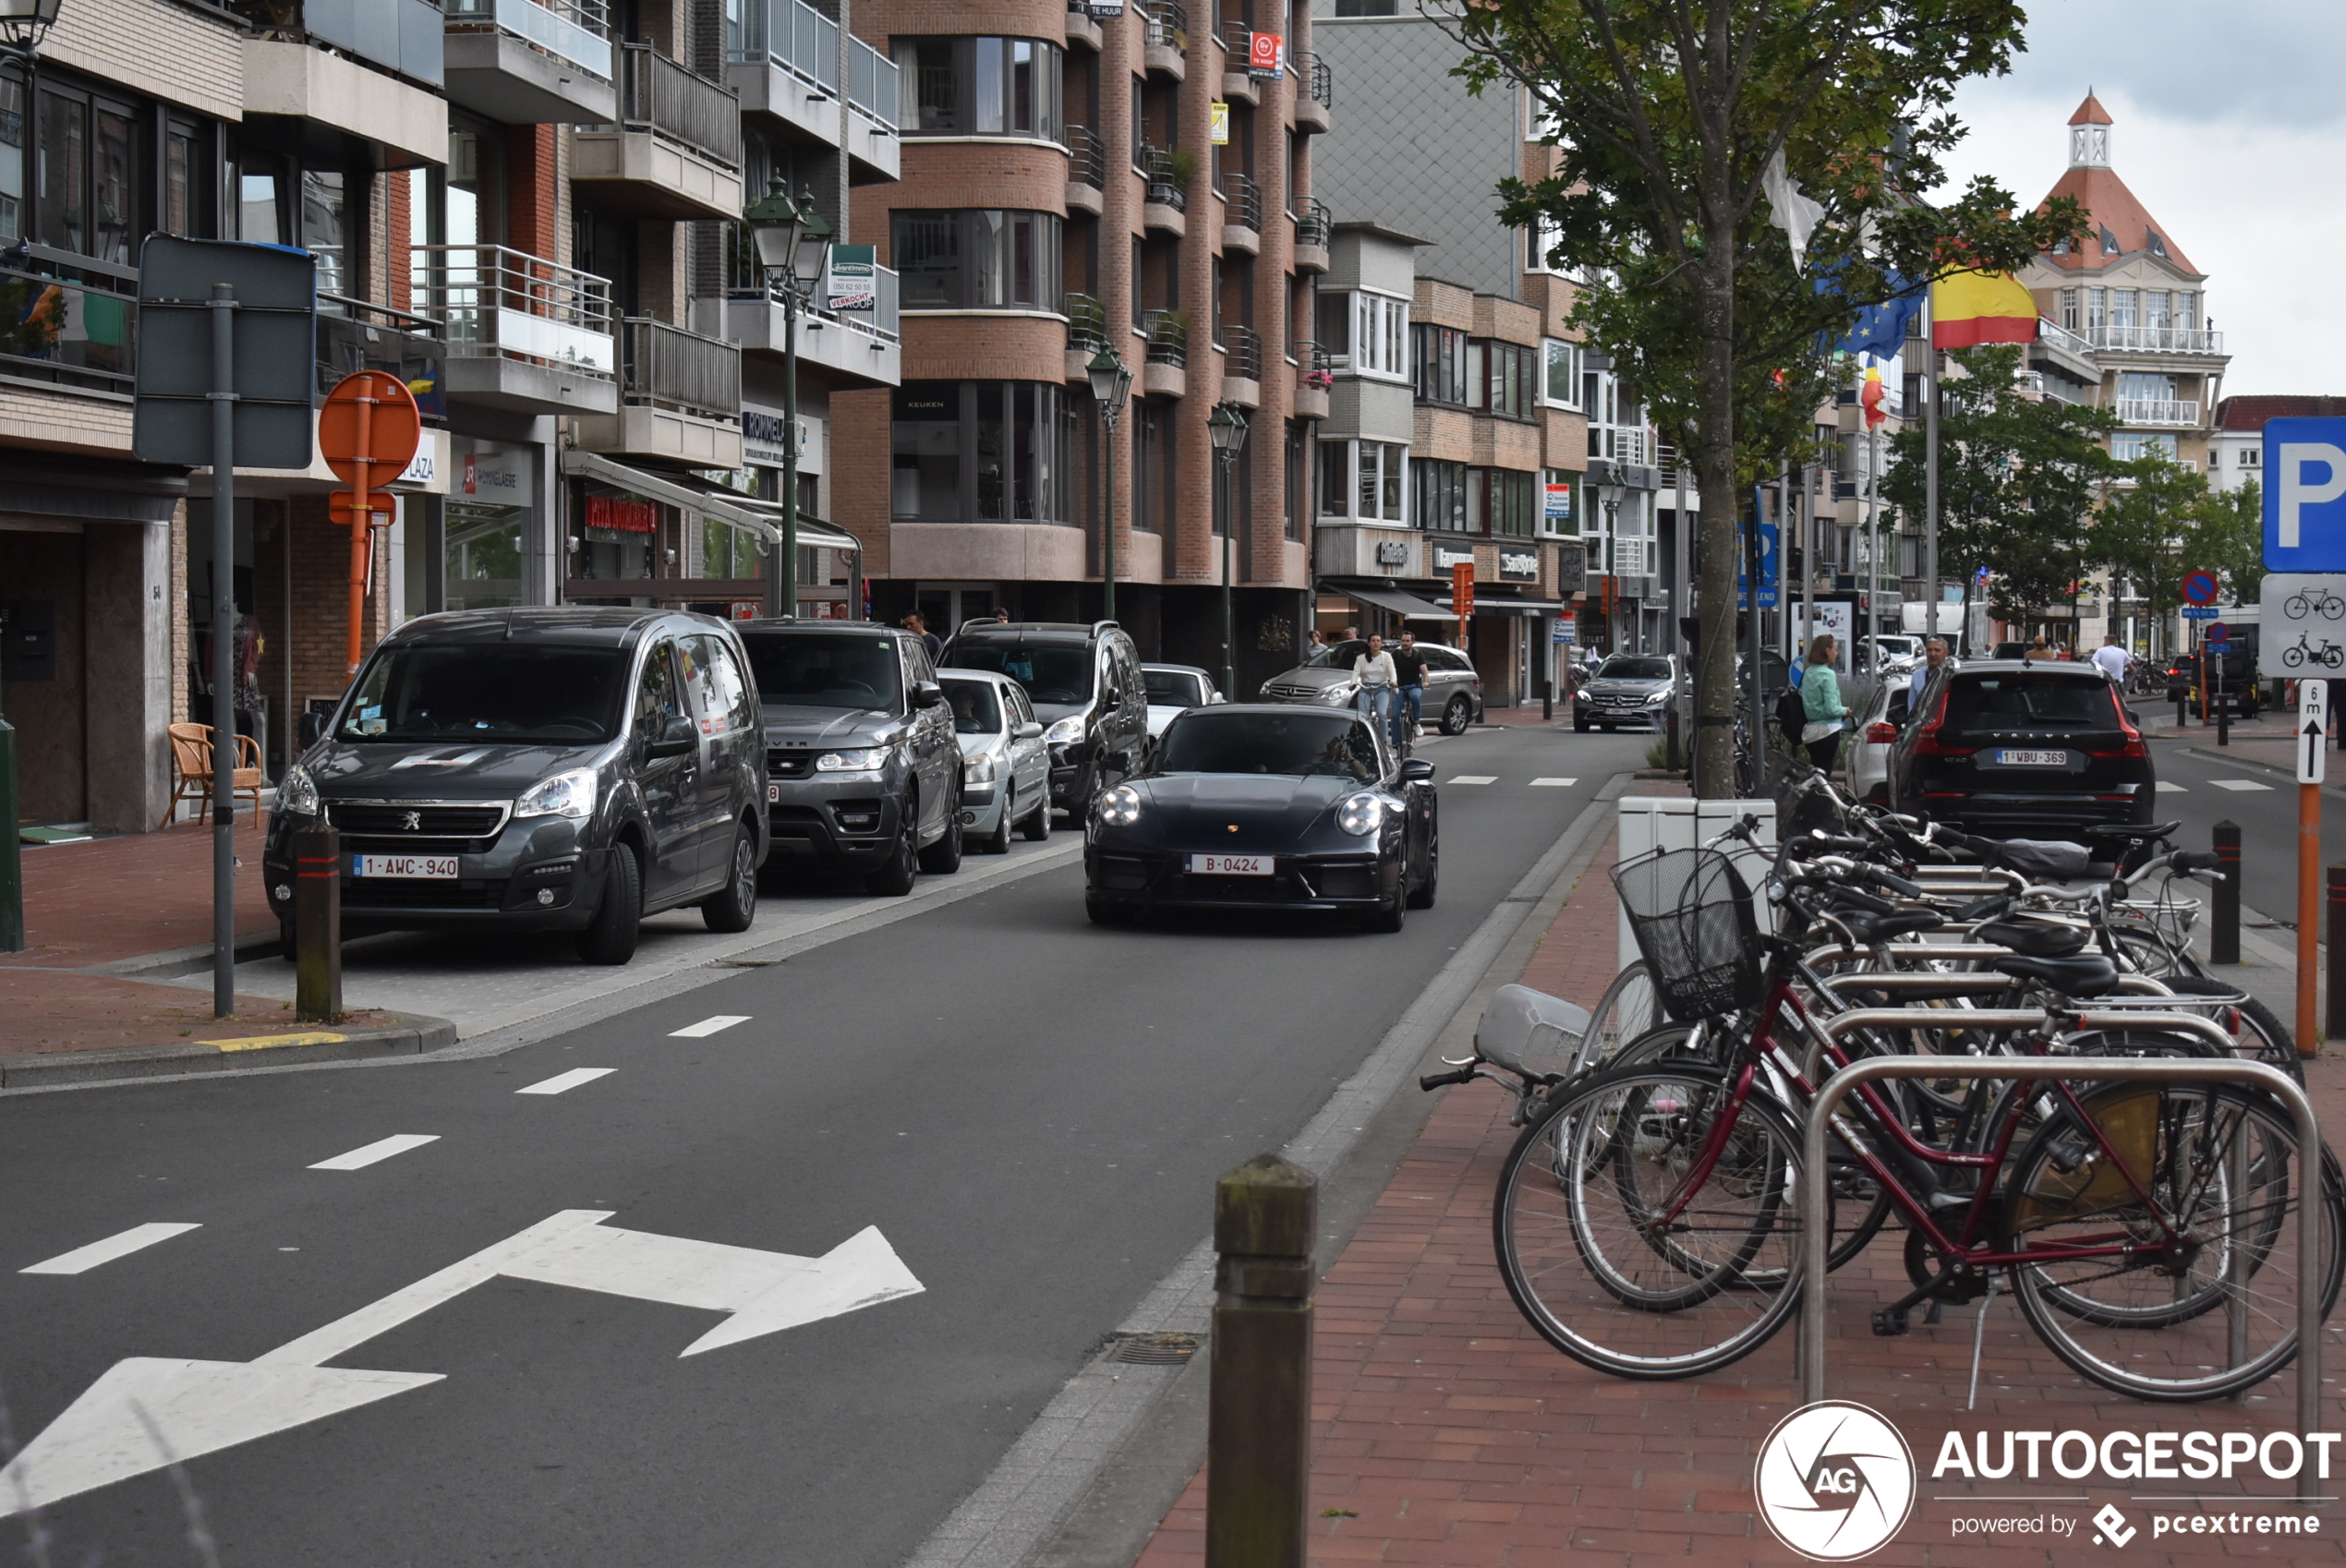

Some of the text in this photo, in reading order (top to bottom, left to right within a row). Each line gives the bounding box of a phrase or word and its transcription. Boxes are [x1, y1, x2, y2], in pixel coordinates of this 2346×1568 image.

[1091, 6, 1122, 16] TE HUUR
[833, 283, 845, 291] 050
[831, 292, 869, 308] VERKOCHT
[466, 464, 475, 484] JR
[478, 469, 516, 488] ROMMELAERE
[2279, 443, 2346, 548] P
[2310, 686, 2317, 701] 6
[2305, 701, 2320, 715] m
[2003, 752, 2065, 763] 1-WBU-369
[367, 858, 457, 875] 1-AWC-940
[1206, 857, 1259, 872] B-0424
[1816, 982, 1844, 1011] Boulevard
